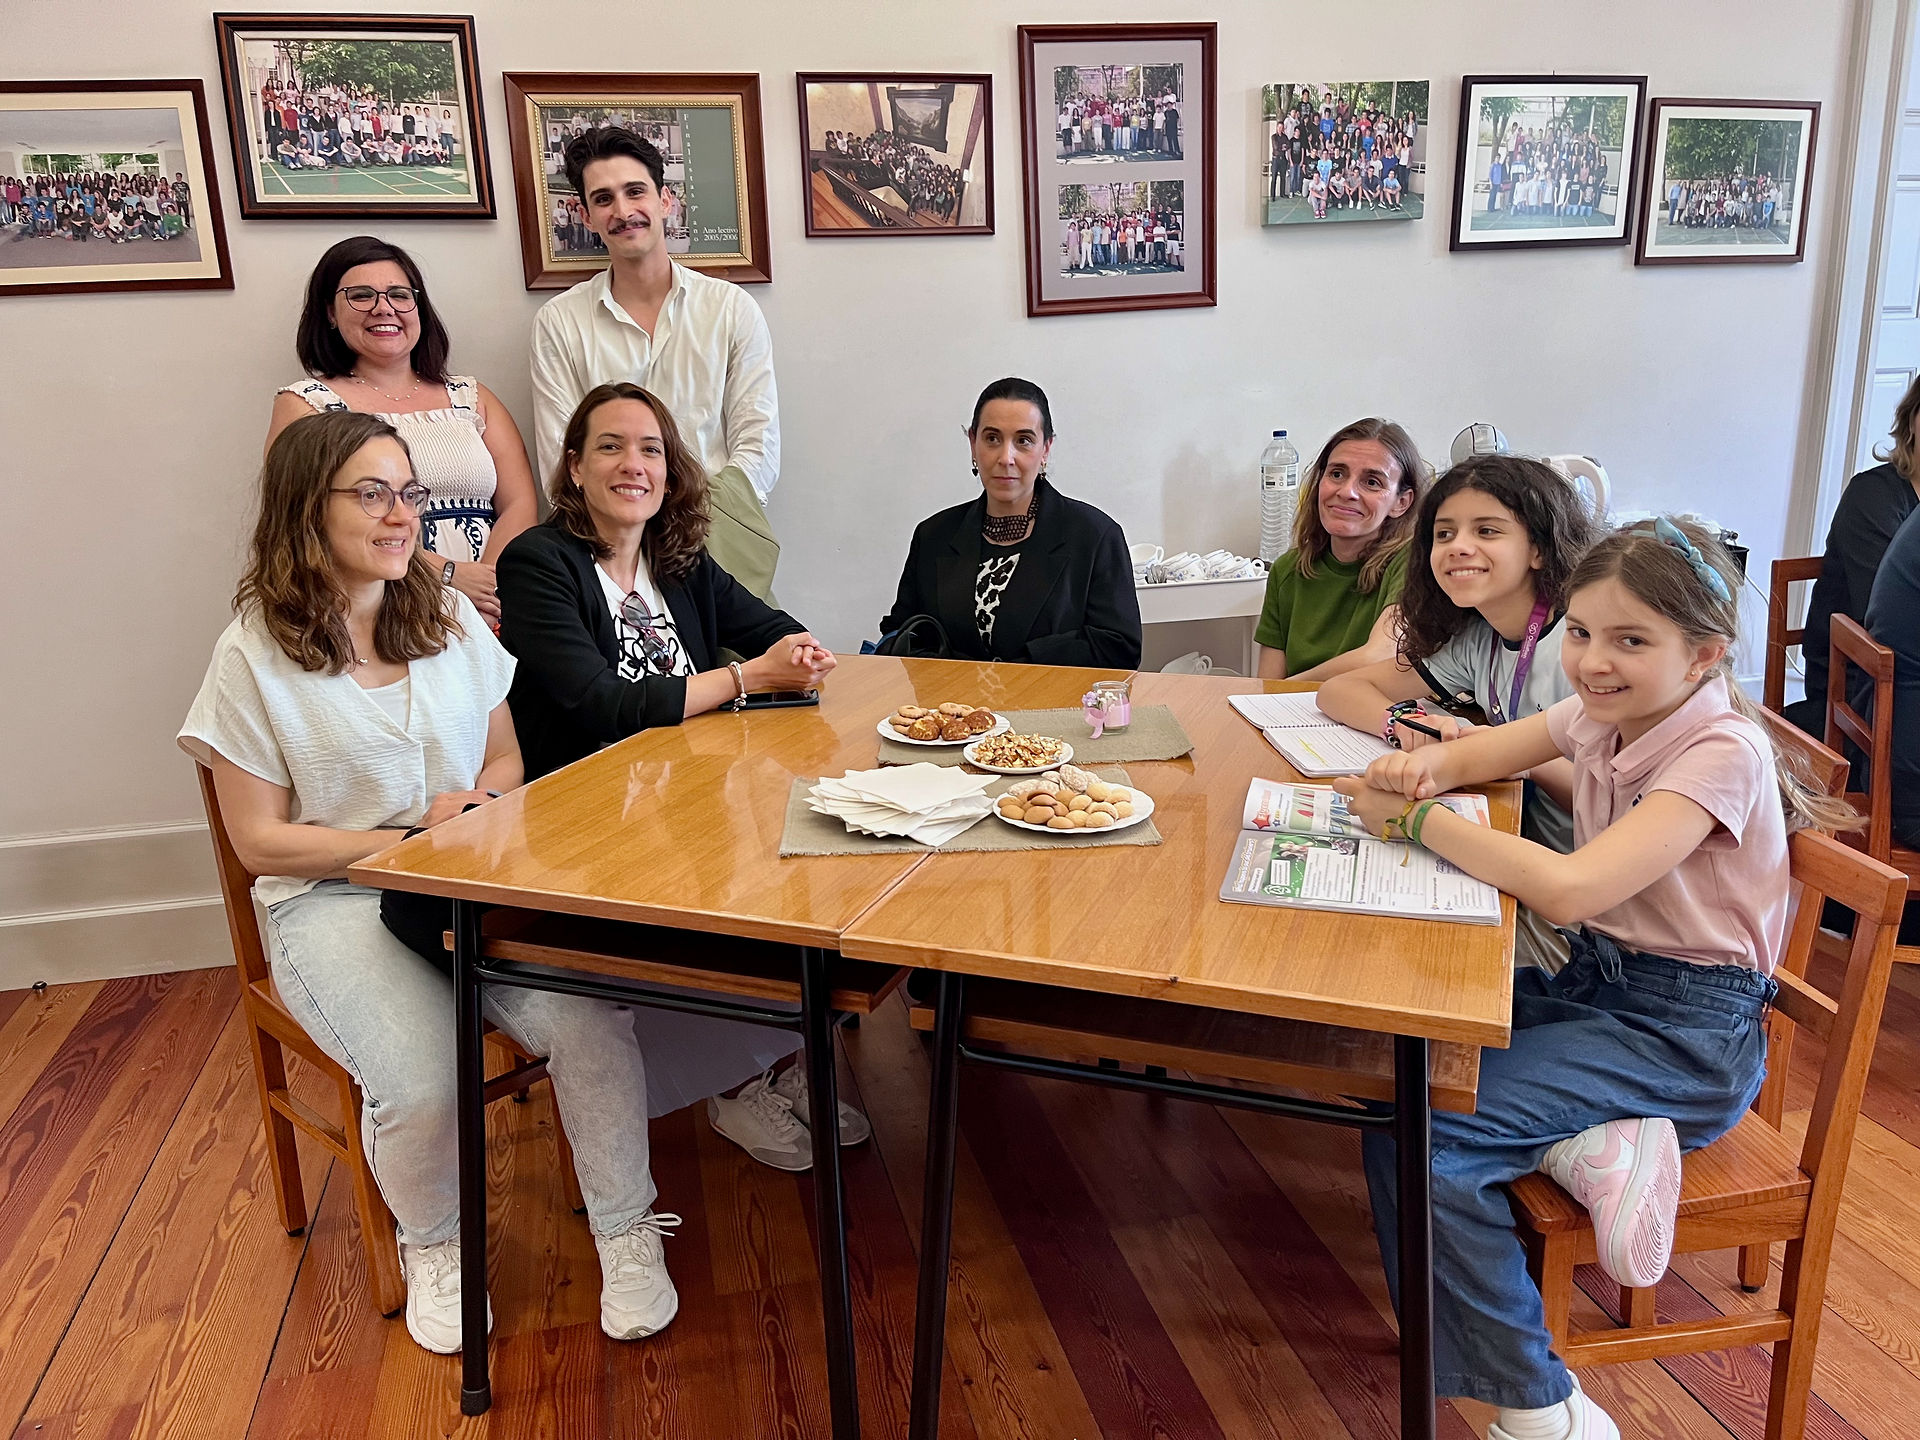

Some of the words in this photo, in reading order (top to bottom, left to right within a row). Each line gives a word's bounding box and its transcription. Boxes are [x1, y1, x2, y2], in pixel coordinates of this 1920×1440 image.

[684, 113, 695, 198] Finalistas
[703, 226, 717, 234] Ano
[717, 226, 739, 234] lectivo
[704, 233, 738, 241] 2005/2006
